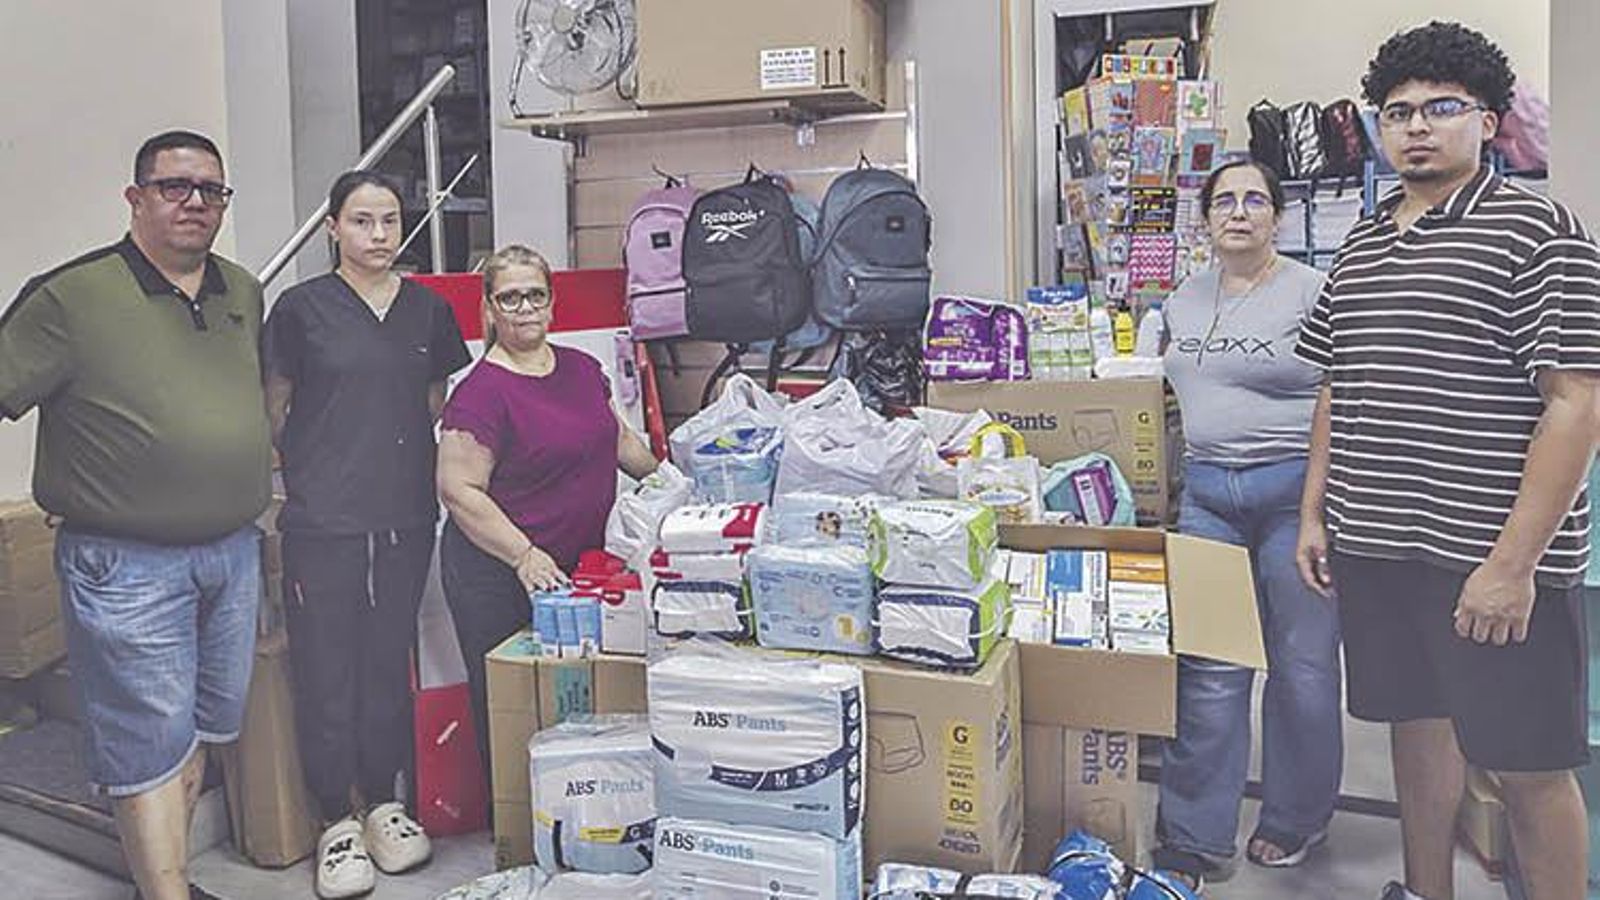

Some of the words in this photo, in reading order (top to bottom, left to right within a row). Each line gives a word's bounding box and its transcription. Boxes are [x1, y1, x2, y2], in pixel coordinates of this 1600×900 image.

[701, 209, 757, 224] Reebok
[998, 412, 1057, 430] Pants
[694, 711, 730, 729] ABS
[736, 714, 785, 732] Pants
[953, 726, 969, 744] G
[1082, 728, 1102, 784] ants
[565, 780, 597, 797] ABS
[774, 772, 788, 787] M
[659, 829, 695, 851] ABS
[702, 838, 755, 860] Pants
